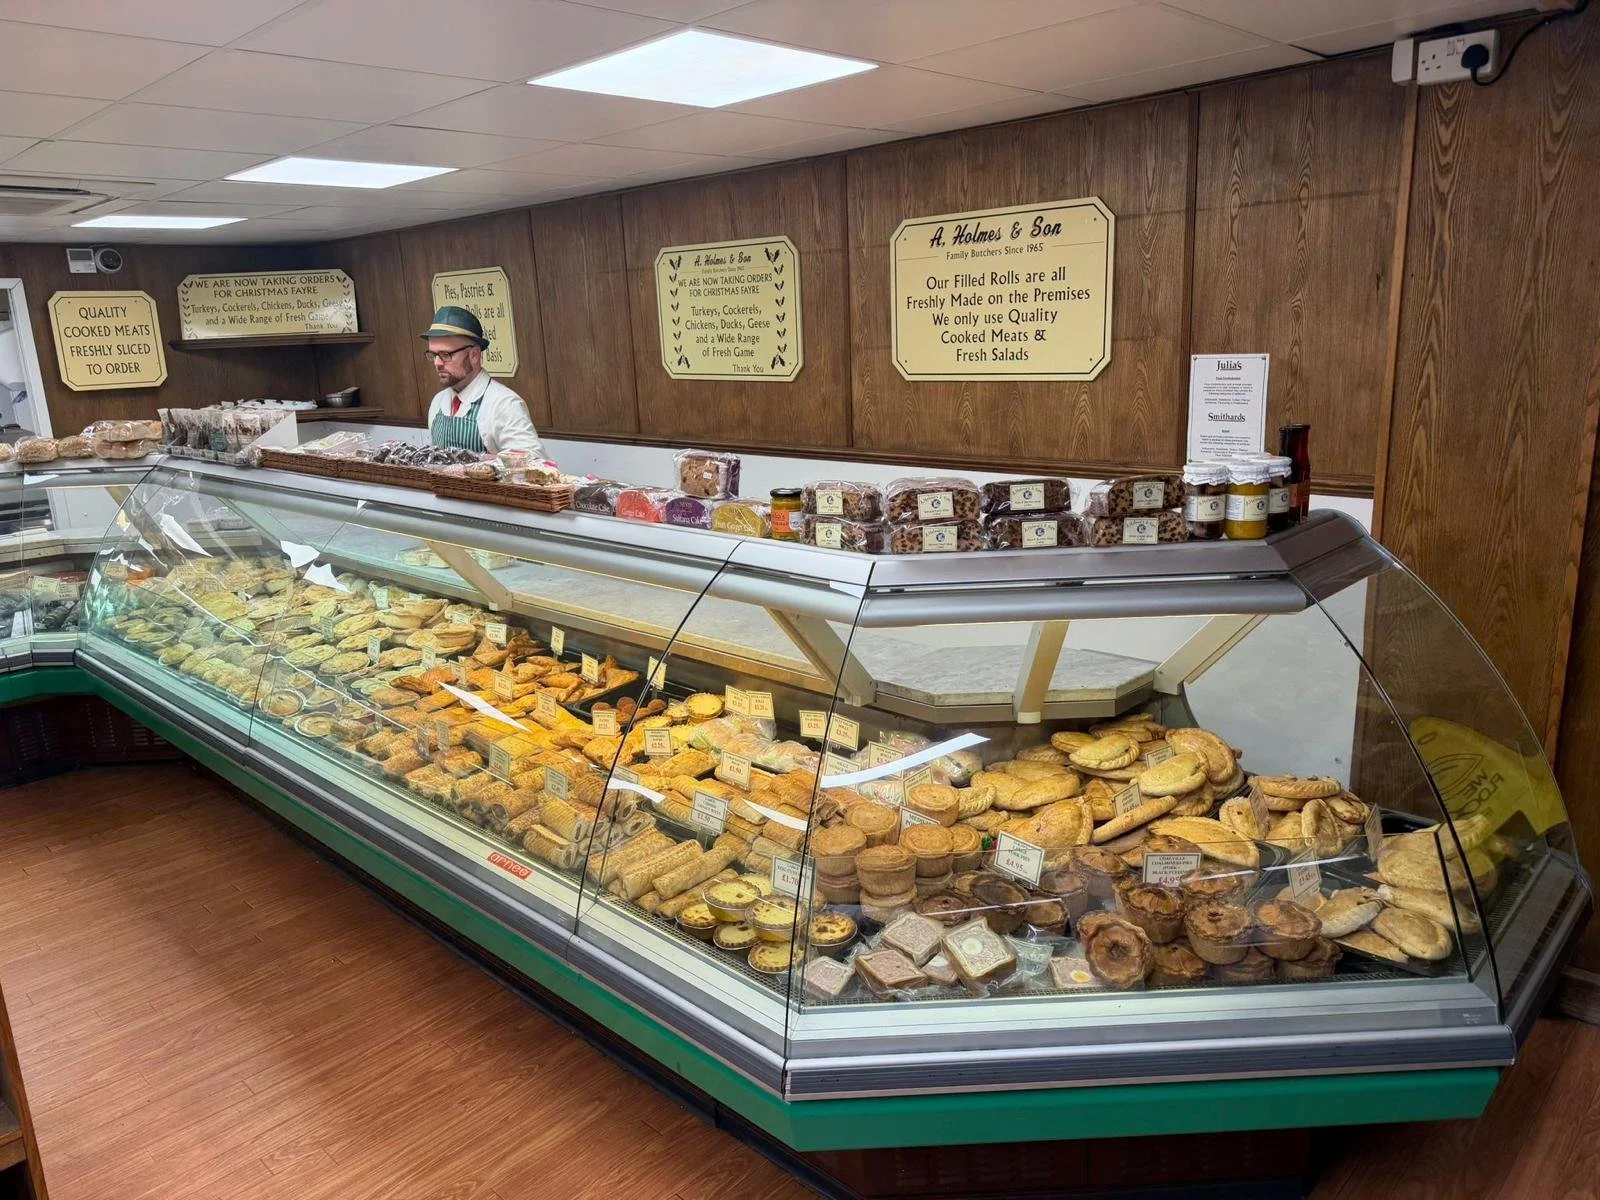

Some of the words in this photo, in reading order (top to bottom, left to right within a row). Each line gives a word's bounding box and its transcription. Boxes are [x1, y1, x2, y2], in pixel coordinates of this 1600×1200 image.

[952, 221, 1002, 246] Holmes
[1010, 221, 1023, 239] &
[1030, 215, 1062, 237] Son
[703, 253, 727, 266] Holmes
[729, 254, 735, 263] &
[738, 251, 752, 263] Son
[946, 251, 969, 261] Family
[971, 246, 1002, 259] Butchers
[1005, 245, 1023, 255] Since
[1026, 243, 1044, 253] 1965
[194, 280, 209, 288] WE
[213, 279, 230, 287] ARE
[234, 278, 258, 287] NOW
[262, 276, 297, 286] TAKING
[300, 275, 335, 284] ORDERS
[689, 278, 700, 287] ARE
[702, 277, 718, 286] NOW
[720, 275, 745, 285] TAKING
[747, 273, 773, 283] ORDERS
[926, 276, 950, 290] Our
[954, 273, 985, 288] Filled
[990, 270, 1020, 286] Rolls
[1025, 273, 1045, 284] are
[1051, 266, 1066, 281] all
[213, 289, 232, 298] FOR
[235, 287, 288, 297] CHRISTMAS
[291, 286, 318, 295] FAYRE
[444, 284, 459, 300] Pies,
[460, 282, 485, 299] Pastries
[487, 283, 494, 296] &
[690, 289, 702, 297] FOR
[703, 287, 739, 297] CHRISTMAS
[740, 285, 760, 295] FAYRE
[906, 296, 945, 310] Freshly
[950, 293, 983, 308] Made
[988, 294, 1003, 305] on
[1008, 290, 1029, 304] the
[1034, 286, 1090, 303] Premises
[78, 306, 127, 320] QUALITY
[191, 304, 220, 315] Turkeys,
[222, 302, 260, 313] Cockerels,
[261, 300, 295, 311] Chickens,
[297, 299, 320, 309] Ducks,
[484, 306, 494, 318] are
[497, 303, 505, 318] all
[691, 305, 721, 318] Turkeys,
[722, 304, 762, 316] Cockerels,
[205, 318, 219, 326] and
[228, 315, 248, 324] Wide
[250, 314, 273, 326] Range
[275, 313, 283, 322] of
[286, 312, 306, 322] Fresh
[685, 320, 718, 331] Chickens,
[720, 319, 746, 330] Ducks,
[747, 318, 770, 329] Geese
[932, 313, 949, 326] We
[954, 310, 979, 327] only
[984, 313, 1003, 324] use
[1008, 308, 1058, 325] Quality
[63, 325, 111, 338] COOKED
[114, 324, 151, 337] MEATS
[941, 329, 986, 344] Cooked
[991, 329, 1029, 342] Meats
[1034, 329, 1047, 341] &
[695, 335, 708, 344] and
[717, 333, 735, 344] Wide
[737, 334, 760, 345] Range
[70, 344, 113, 357] FRESHLY
[116, 343, 151, 356] SLICED
[702, 347, 709, 357] of
[712, 347, 731, 357] Fresh
[733, 347, 755, 357] Game
[956, 348, 987, 362] Fresh
[992, 347, 1029, 361] Salads
[86, 363, 102, 375] TO
[105, 362, 141, 374] ORDER
[732, 364, 750, 373] Thank
[752, 364, 764, 373] You
[1215, 360, 1242, 371] Julia's
[1207, 412, 1246, 423] Smithards
